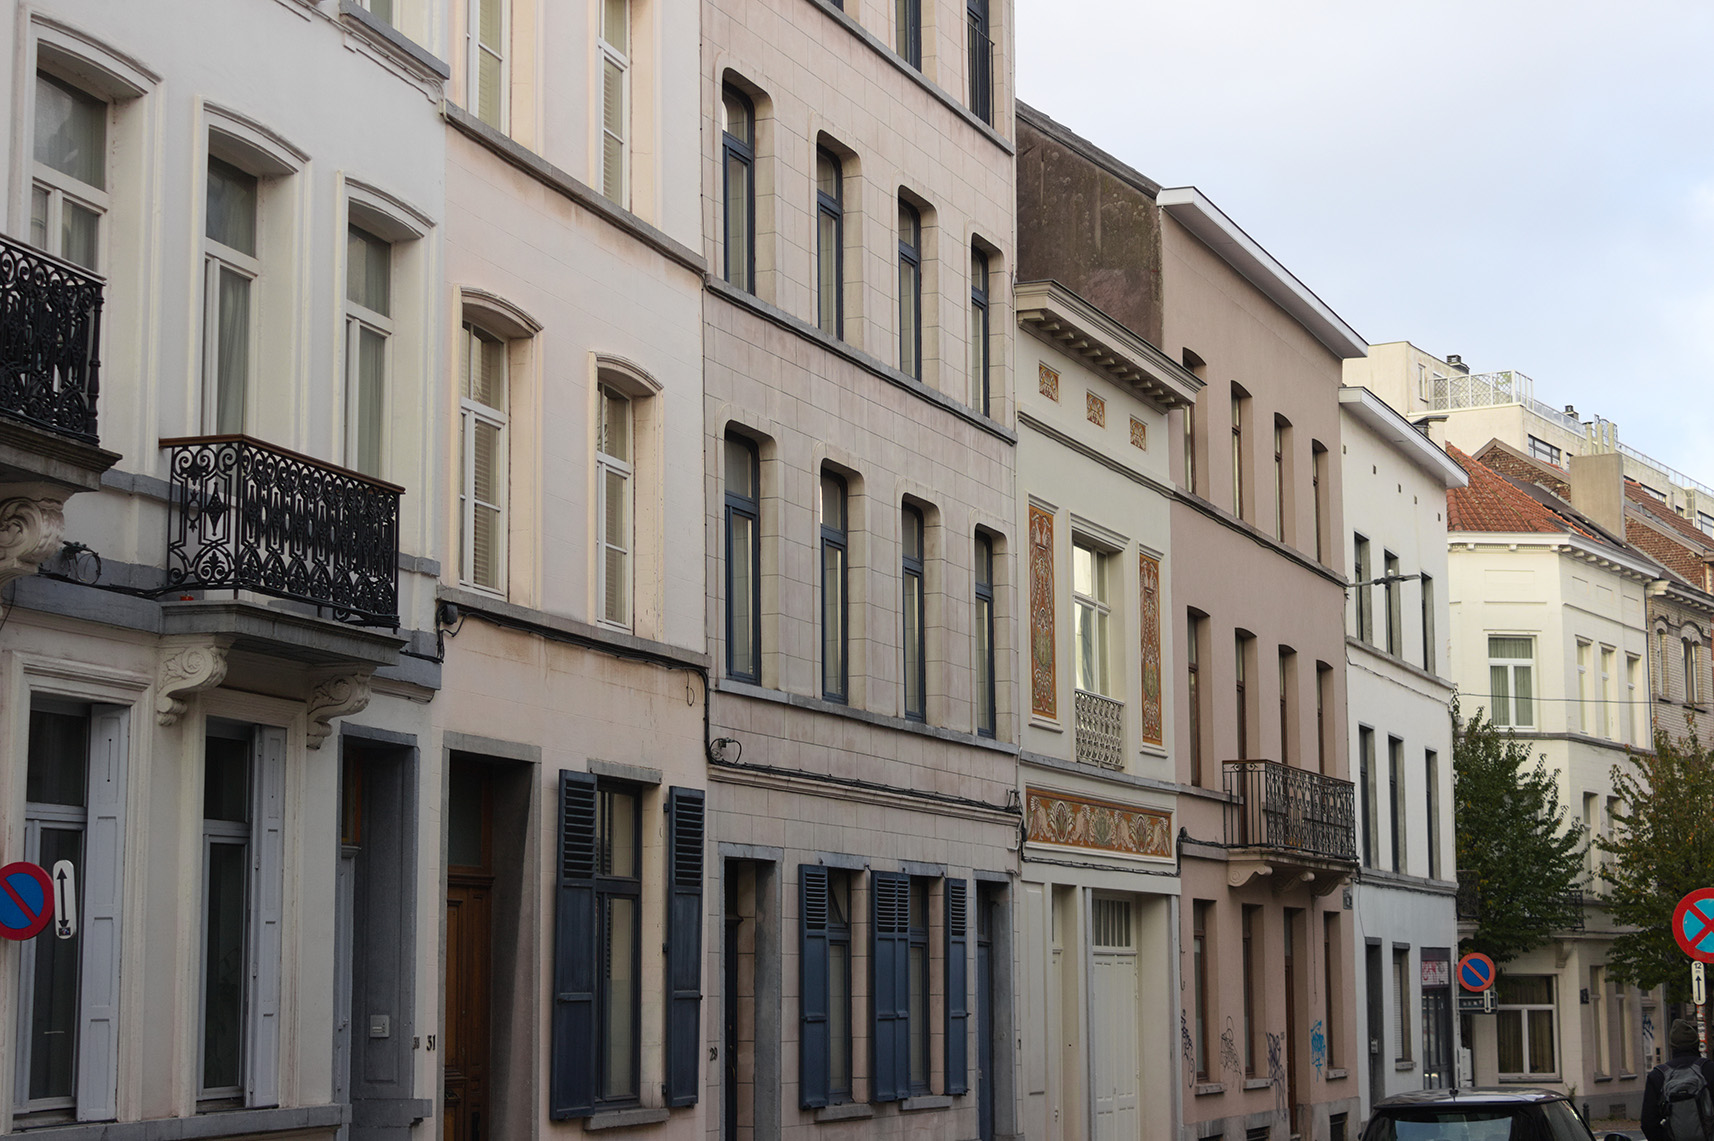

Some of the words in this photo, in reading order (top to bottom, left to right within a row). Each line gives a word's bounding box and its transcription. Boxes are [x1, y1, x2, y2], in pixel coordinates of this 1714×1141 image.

[1694, 962, 1702, 970] 12
[426, 1034, 436, 1051] 31
[709, 1046, 718, 1061] 29
